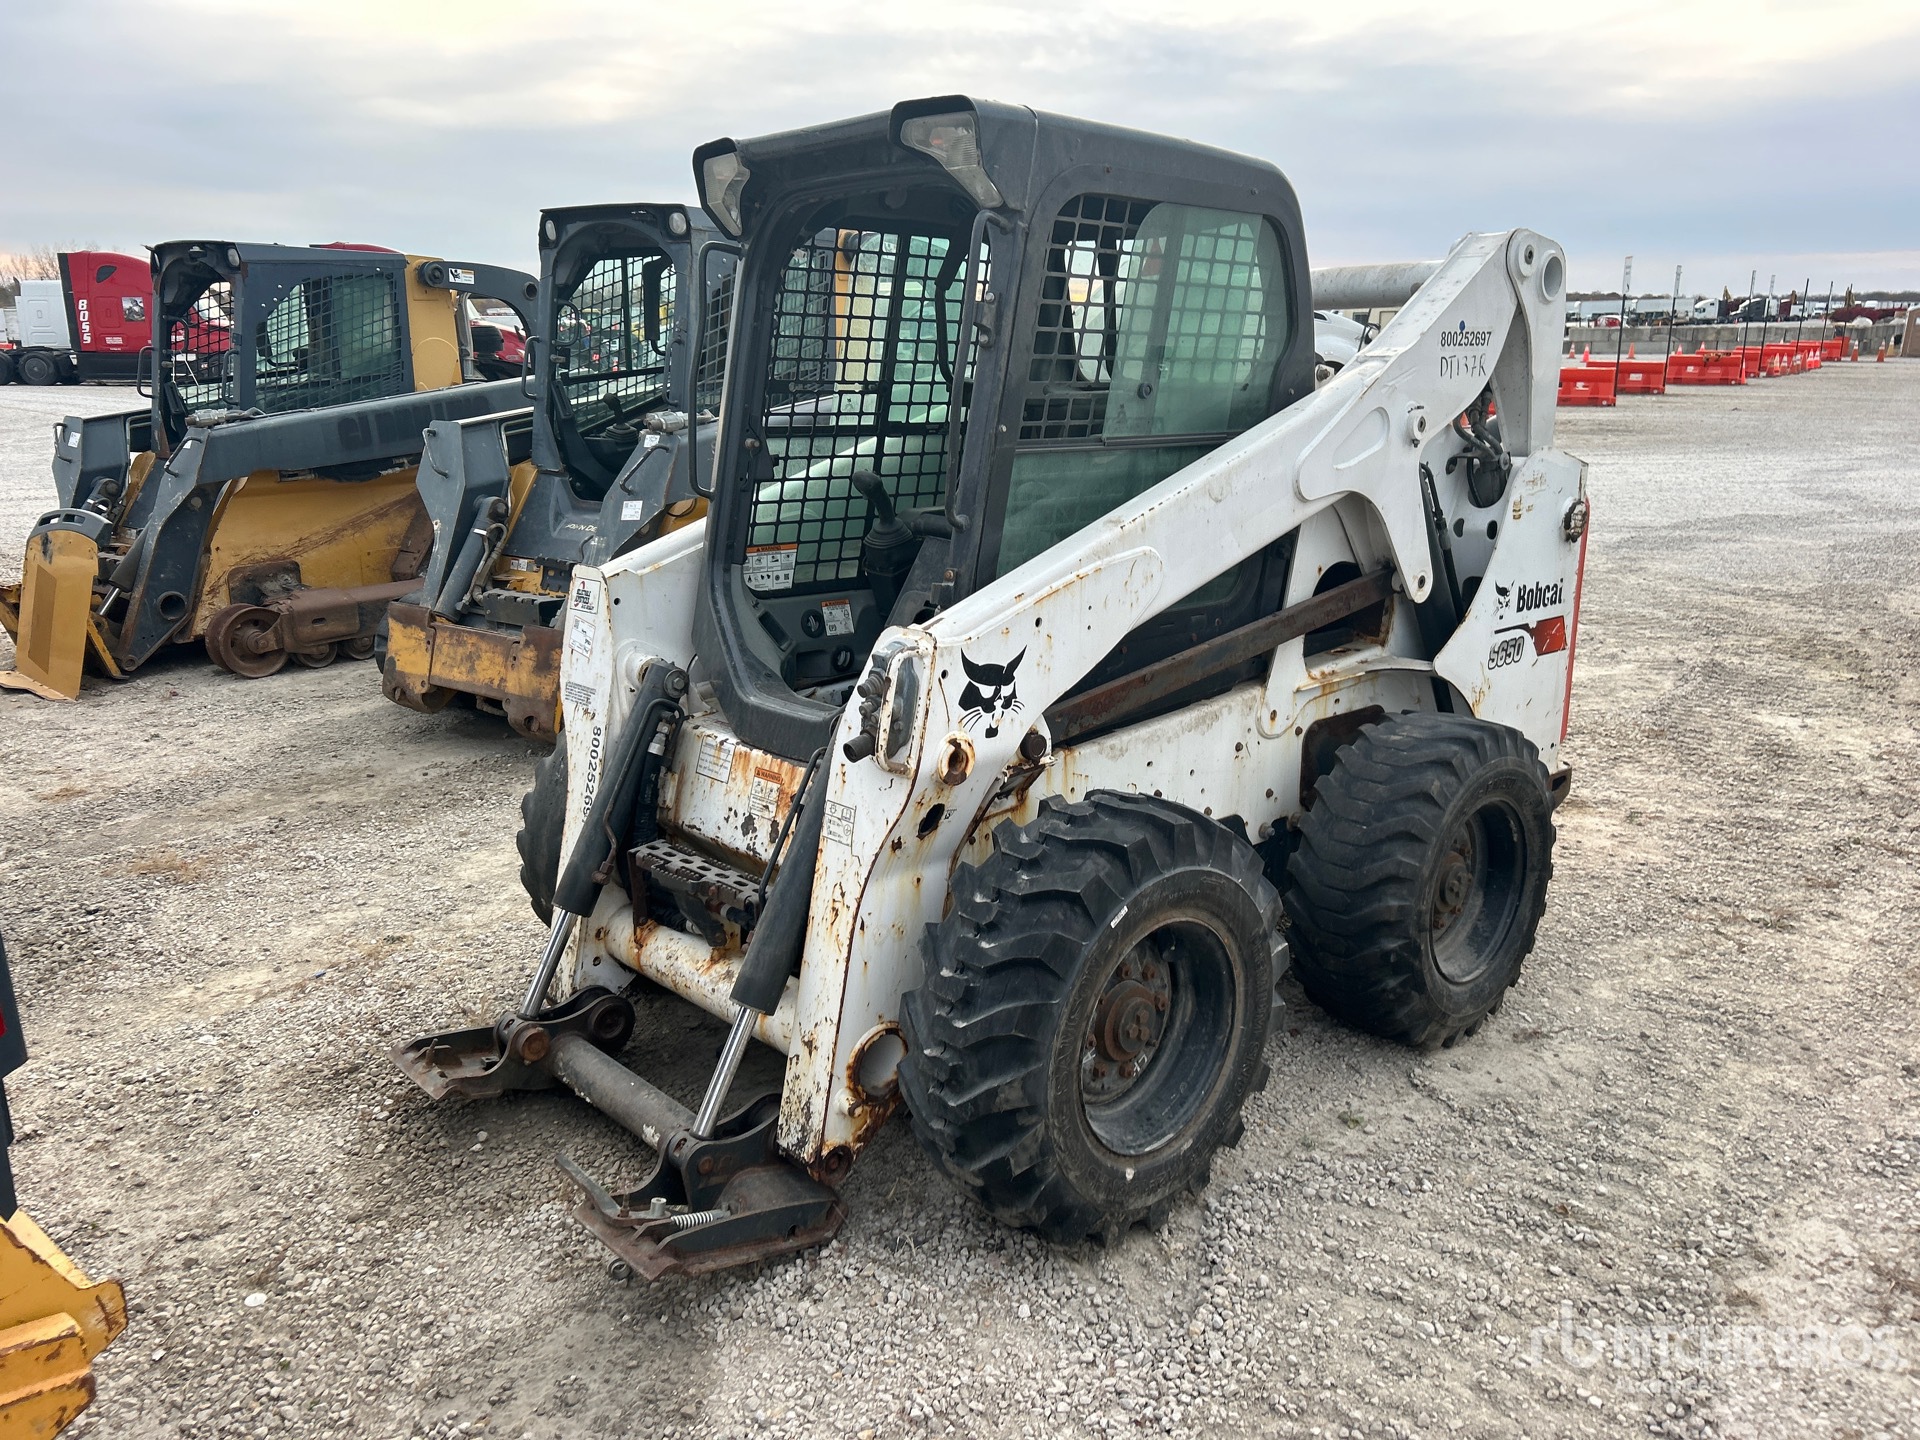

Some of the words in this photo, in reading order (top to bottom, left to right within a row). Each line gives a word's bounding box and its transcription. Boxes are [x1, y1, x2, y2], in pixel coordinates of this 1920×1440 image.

[1440, 331, 1492, 347] 800252697
[1487, 635, 1525, 671] S650
[581, 725, 602, 823] 80025269
[761, 771, 781, 782] WARNING
